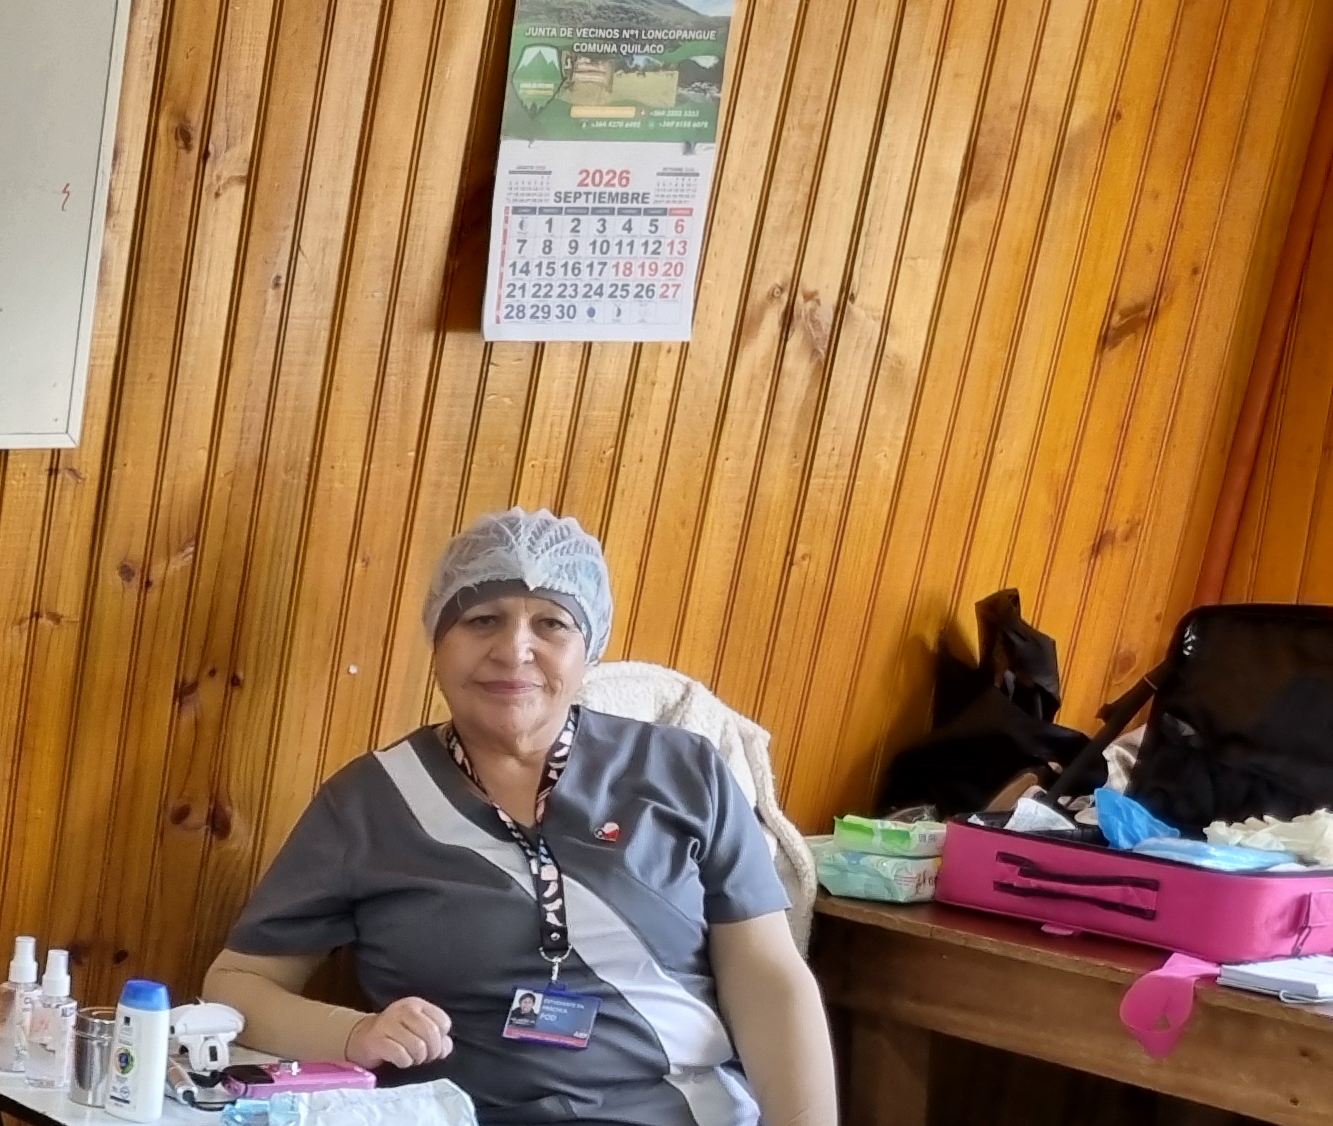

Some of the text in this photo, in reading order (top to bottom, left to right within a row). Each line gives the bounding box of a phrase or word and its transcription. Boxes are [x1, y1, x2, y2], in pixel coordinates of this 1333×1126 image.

[525, 27, 557, 38] JUNTA
[560, 28, 573, 38] DE
[575, 28, 620, 39] VECINOS
[641, 29, 717, 41] LONCOPANGUE
[573, 43, 664, 55] COMUNA QUILACO
[576, 169, 631, 188] 2026
[553, 191, 651, 205] SEPTIEMBRE
[545, 218, 684, 234] 1 2 3 4 5 6
[517, 239, 688, 255] 7 8 9 10 11 12 13
[509, 261, 684, 277] 14 15 16 17 18 19 20
[505, 283, 681, 299] 21 22 23 24 25 26 27
[503, 304, 577, 320] 28 29 30
